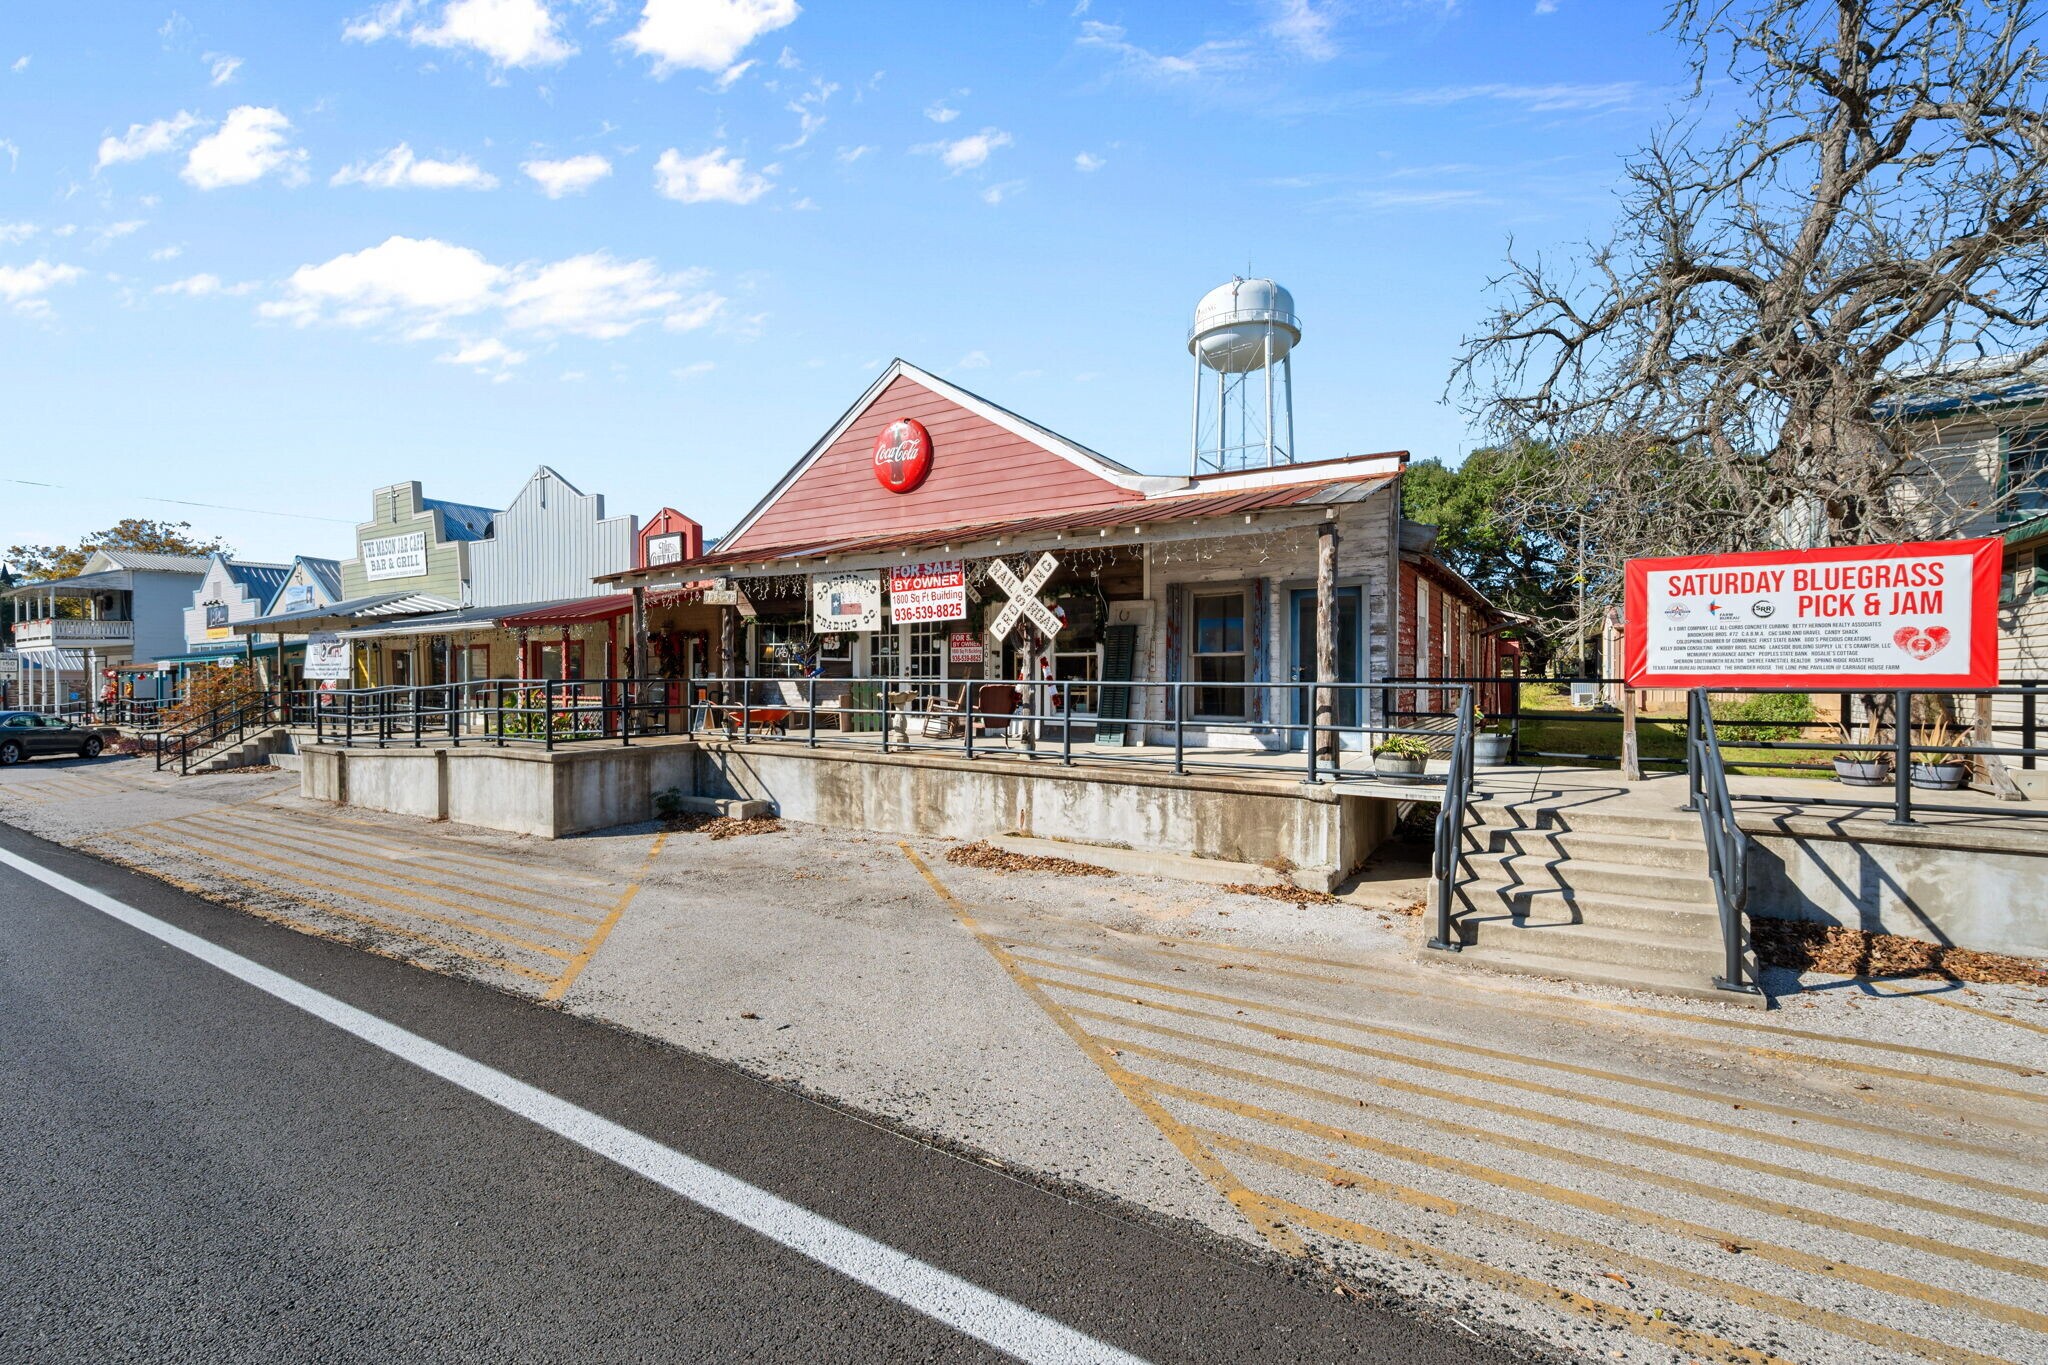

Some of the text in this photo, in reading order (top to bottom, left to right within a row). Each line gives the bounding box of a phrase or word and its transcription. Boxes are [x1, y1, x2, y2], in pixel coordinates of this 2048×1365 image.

[875, 438, 920, 466] Coca-Cola
[364, 533, 424, 558] THE MASON JAR CAFE
[371, 554, 420, 571] BAR & GRILL
[893, 560, 961, 579] FOR SALE
[817, 574, 877, 600] COLDSPRING
[895, 573, 959, 590] BY OWNER
[991, 562, 1016, 594] RAIL
[1668, 562, 1944, 597] SATURDAY BLUEGRASS
[893, 594, 908, 604] 1800
[911, 593, 920, 604] Sq
[931, 590, 963, 601] Building
[996, 560, 1052, 634] CROSSING
[1799, 590, 1943, 618] PICK & JAM
[816, 613, 858, 631] TRADING
[895, 603, 962, 622] 936-539-8825
[1027, 602, 1060, 635] ROAD
